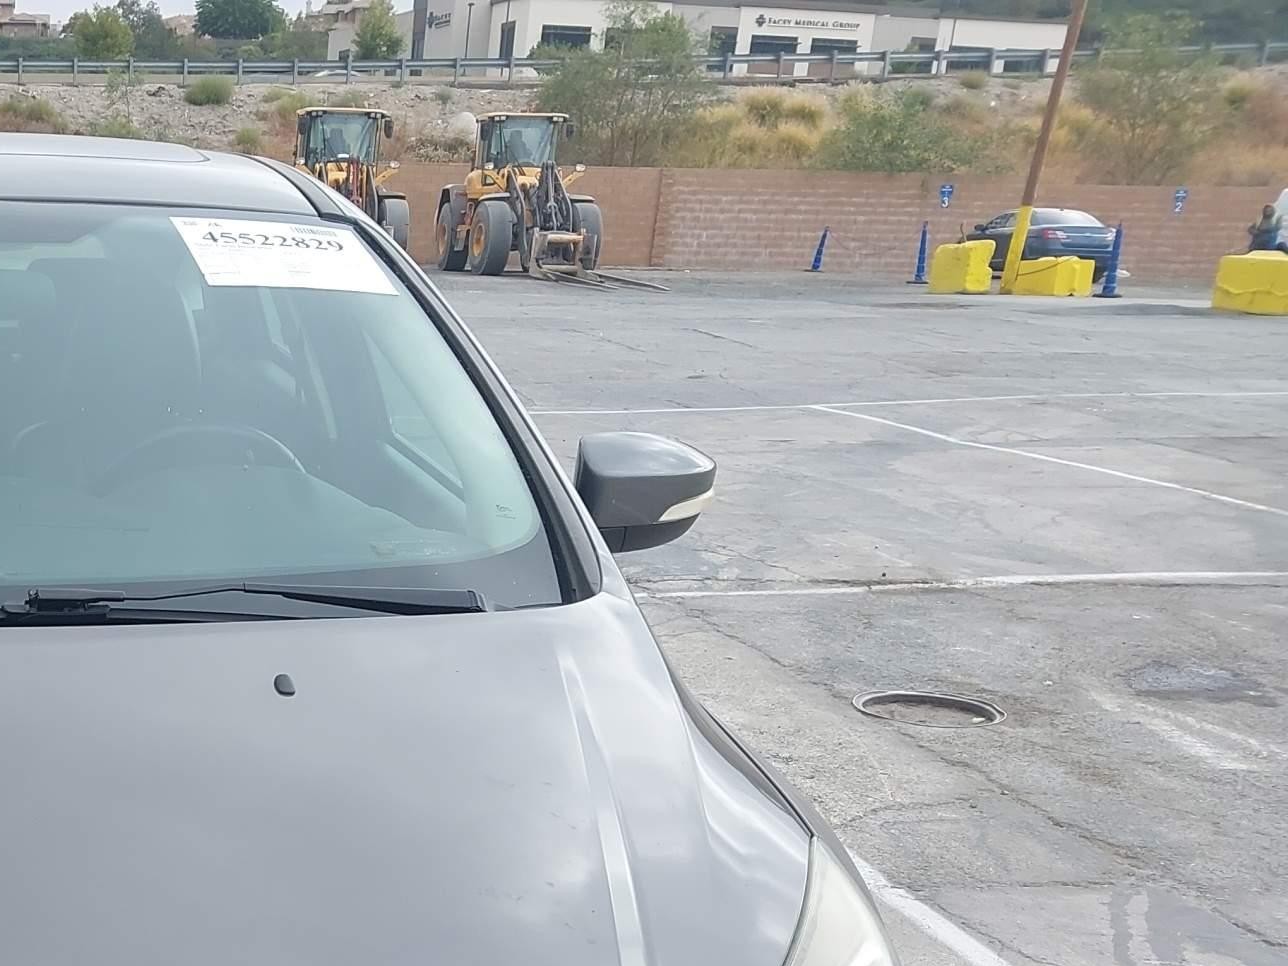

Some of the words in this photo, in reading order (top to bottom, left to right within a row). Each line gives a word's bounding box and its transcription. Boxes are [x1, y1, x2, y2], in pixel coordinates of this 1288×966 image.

[794, 18, 829, 27] MEDICAL
[832, 21, 860, 29] GROUP
[202, 231, 344, 252] 45522829
